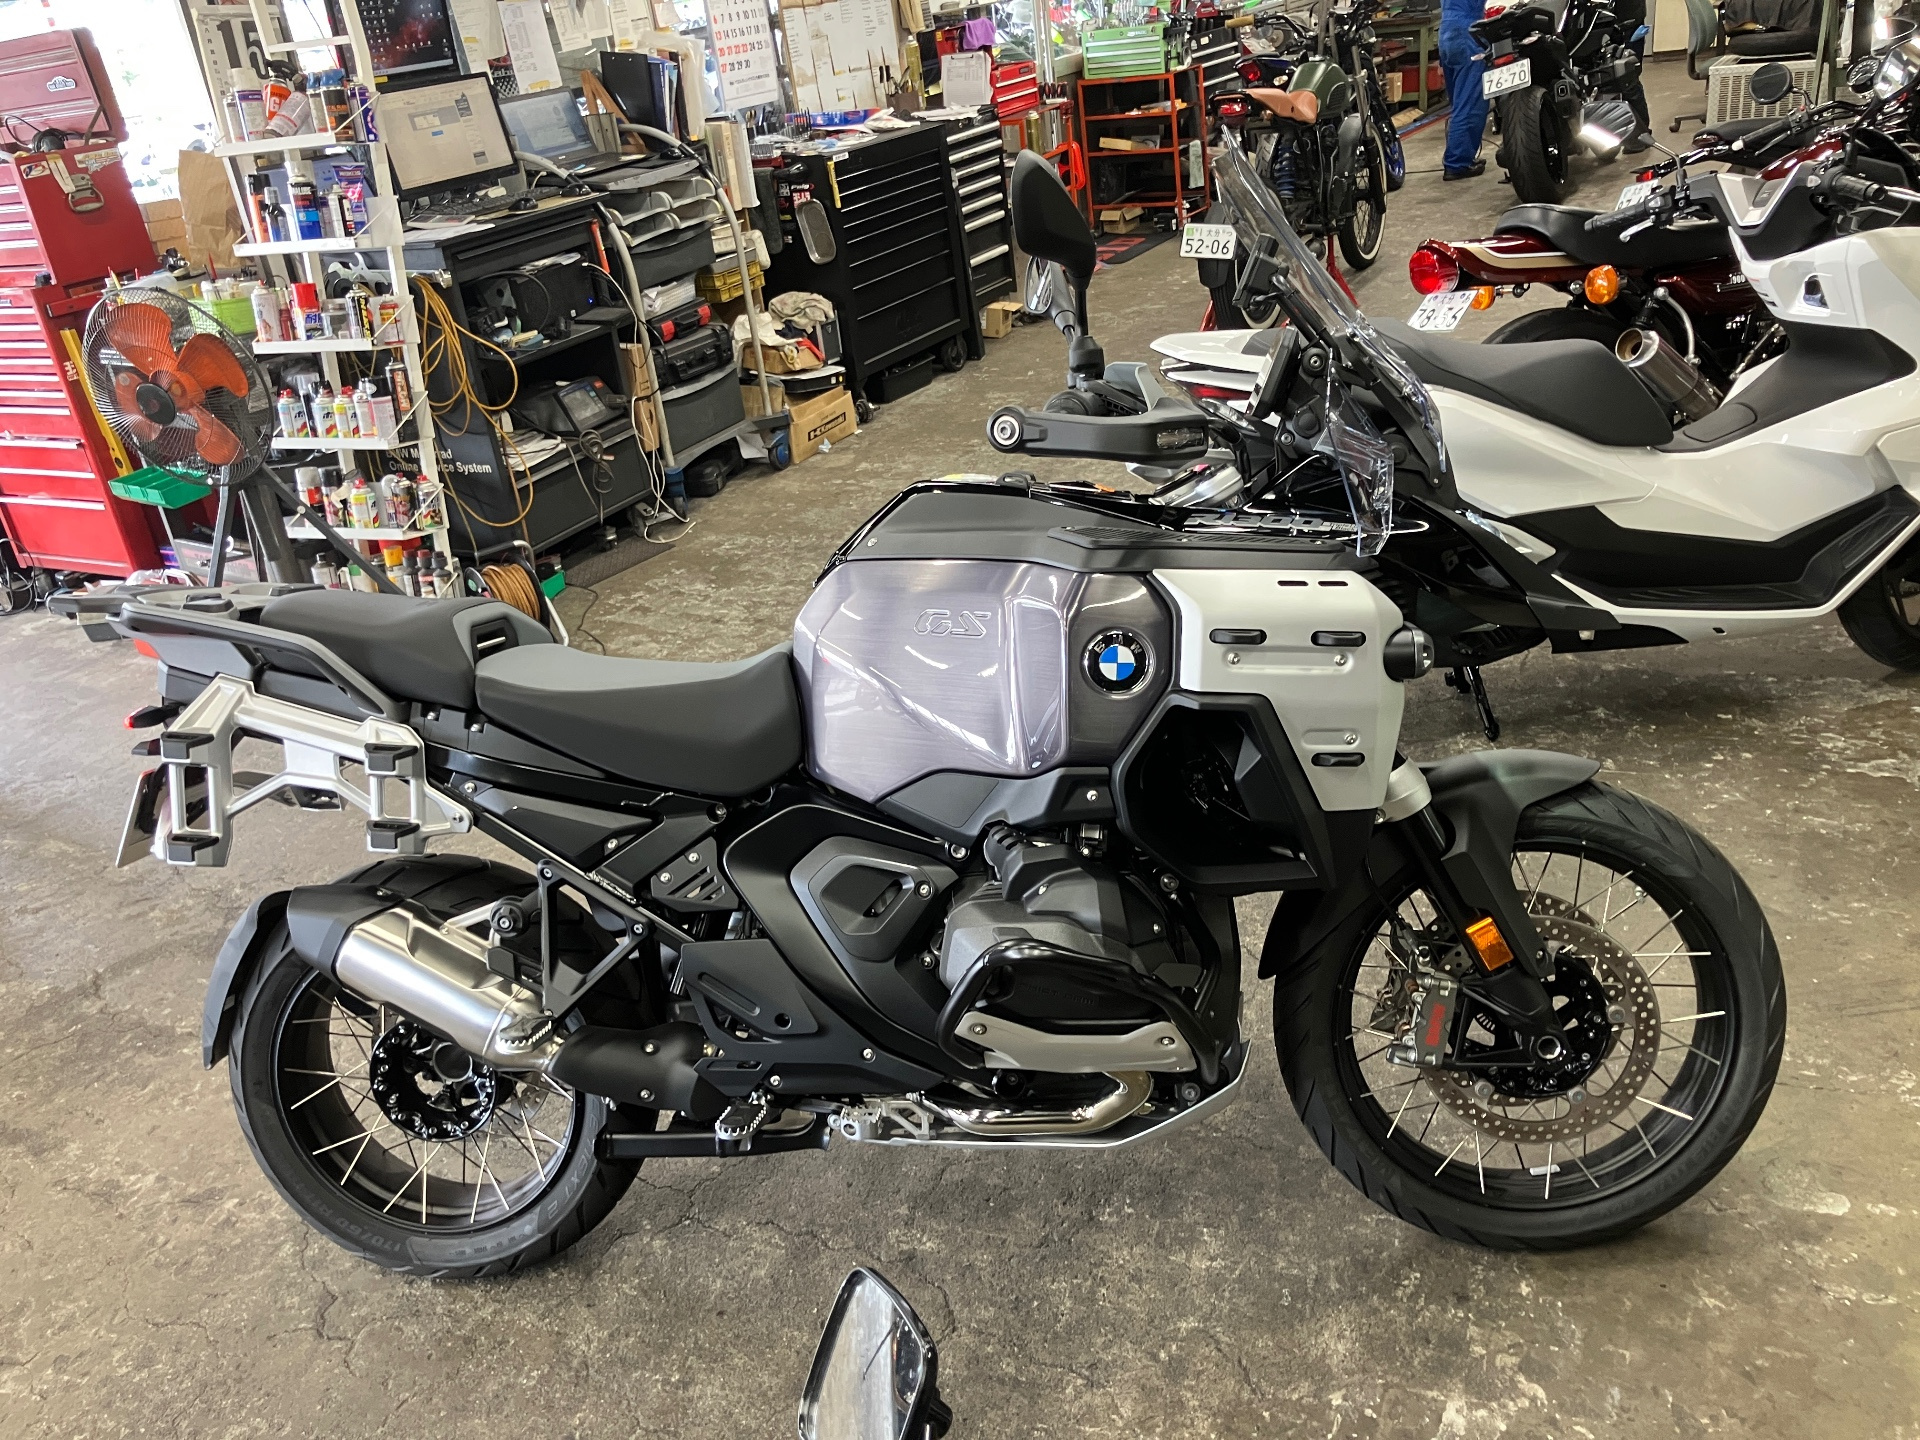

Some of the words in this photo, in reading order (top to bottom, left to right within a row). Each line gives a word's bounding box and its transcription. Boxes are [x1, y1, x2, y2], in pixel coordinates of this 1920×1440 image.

[721, 13, 725, 23] 7
[728, 13, 733, 22] 8
[736, 11, 741, 21] 9
[743, 10, 750, 20] 10
[750, 9, 758, 18] 11
[715, 31, 722, 41] 13
[723, 30, 730, 40] 14
[731, 28, 738, 38] 15
[739, 27, 746, 37] 16
[746, 26, 752, 36] 17
[753, 25, 760, 34] 18
[718, 47, 726, 57] 20
[726, 46, 733, 56] 21
[734, 45, 741, 55] 22
[741, 44, 749, 53] 23
[749, 42, 756, 52] 24
[756, 41, 763, 50] 25
[721, 63, 728, 74] 27
[729, 62, 736, 72] 28
[736, 61, 743, 71] 29
[744, 59, 751, 69] 30
[1486, 69, 1527, 92] 76-70
[1206, 229, 1221, 238] 大分
[1184, 238, 1231, 255] 52-06
[455, 461, 493, 475] System
[913, 608, 992, 639] GS
[1093, 633, 1143, 655] BMW
